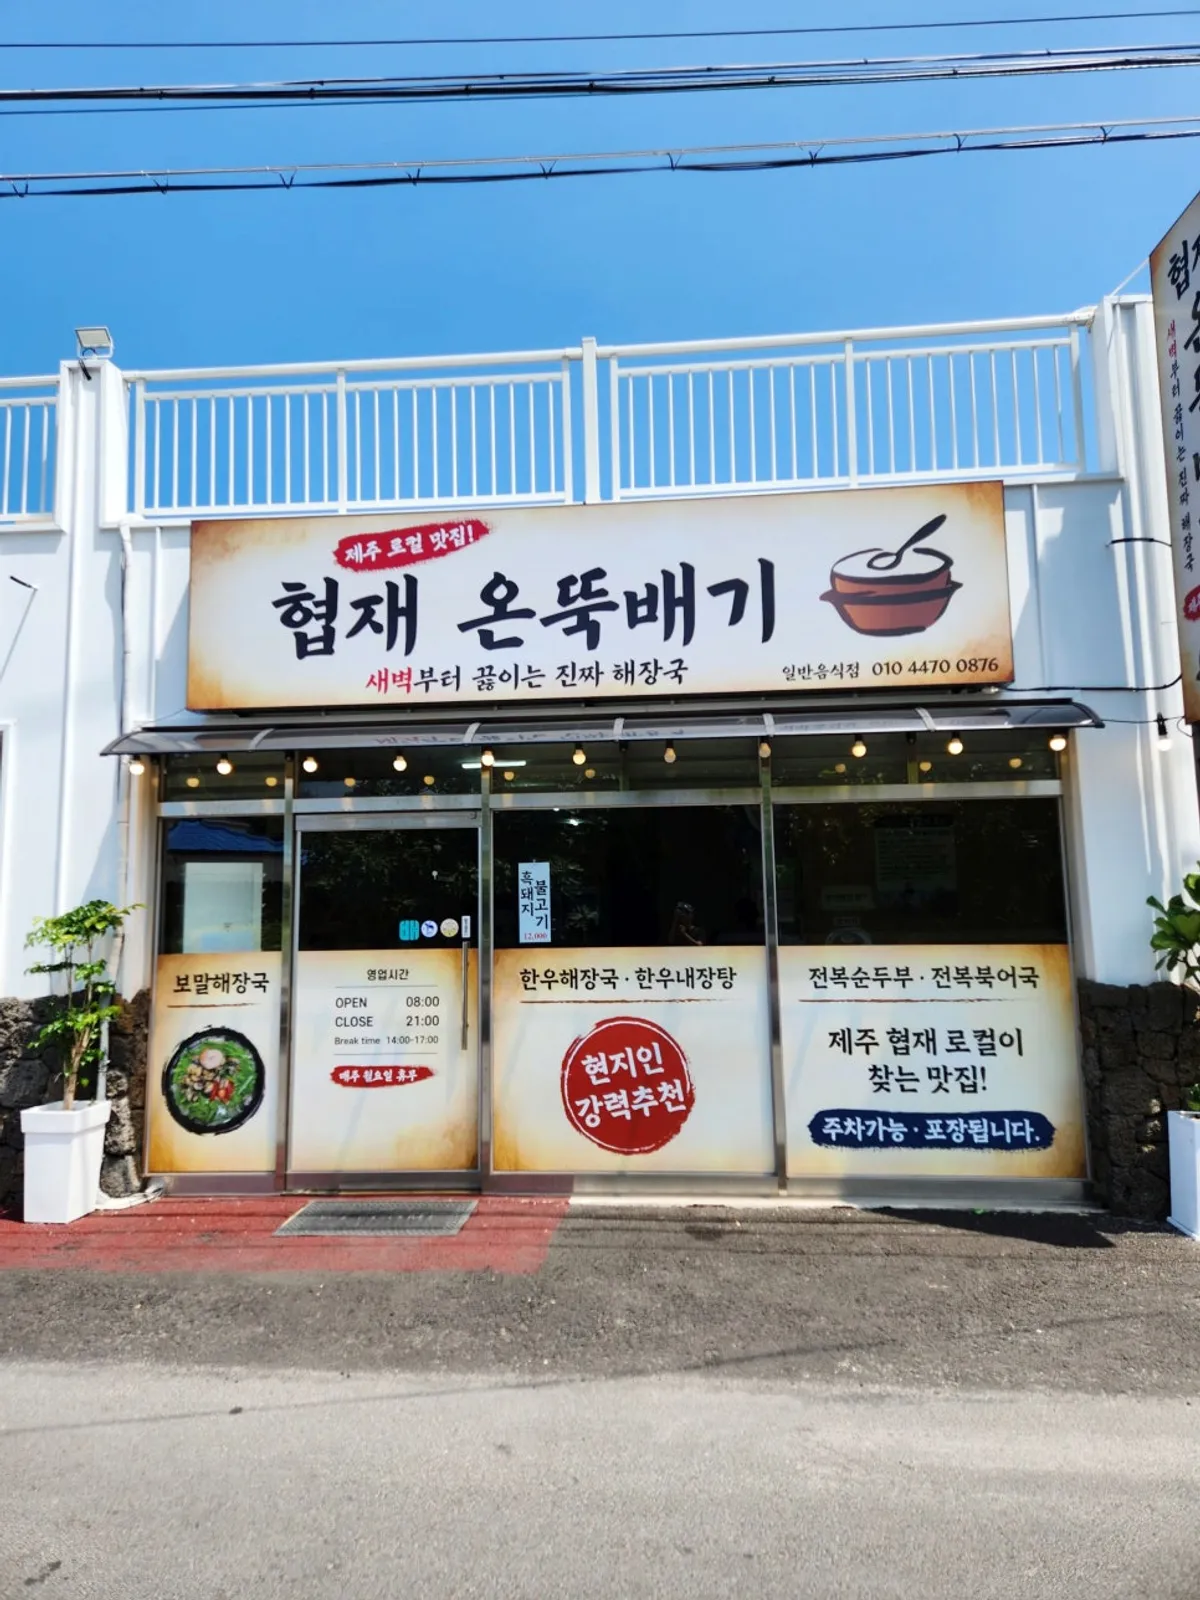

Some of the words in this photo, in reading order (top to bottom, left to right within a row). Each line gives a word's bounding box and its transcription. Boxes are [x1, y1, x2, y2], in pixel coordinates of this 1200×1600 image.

[344, 540, 382, 564] 제주
[387, 535, 423, 556] 로컬
[429, 524, 474, 551] 맛집!
[271, 573, 419, 660] 협재
[457, 557, 775, 651] 온뚝배기
[366, 665, 461, 694] 새벽부터
[472, 661, 546, 692] 끓이는
[555, 664, 604, 688] 진짜
[613, 658, 688, 686] 해장국
[782, 662, 860, 681] 일반음식점
[872, 661, 902, 677] 010
[908, 659, 951, 675] 4470
[956, 657, 999, 673] 0876
[520, 870, 534, 917] 흑돼지
[534, 879, 549, 930] 불고기
[523, 932, 548, 941] 12,000
[173, 972, 270, 995] 보말해장국
[366, 968, 409, 981] 영업시간
[335, 997, 367, 1009] OPEN
[405, 996, 440, 1008] 08:00
[335, 1016, 373, 1028] CLOSE
[405, 1015, 440, 1027] 21:00
[334, 1036, 358, 1045] Break
[361, 1036, 381, 1045] time
[386, 1035, 439, 1045] 14:00-17:00
[828, 1027, 880, 1055] 제주
[886, 1027, 937, 1055] 협재
[945, 1027, 1024, 1056] 로컬이
[339, 1069, 360, 1082] 매주
[363, 1068, 393, 1083] 월요일
[581, 1042, 665, 1086] 현지인
[868, 1064, 920, 1093] 찾는
[927, 1064, 987, 1094] 맛집!
[575, 1078, 687, 1128] 강력추천
